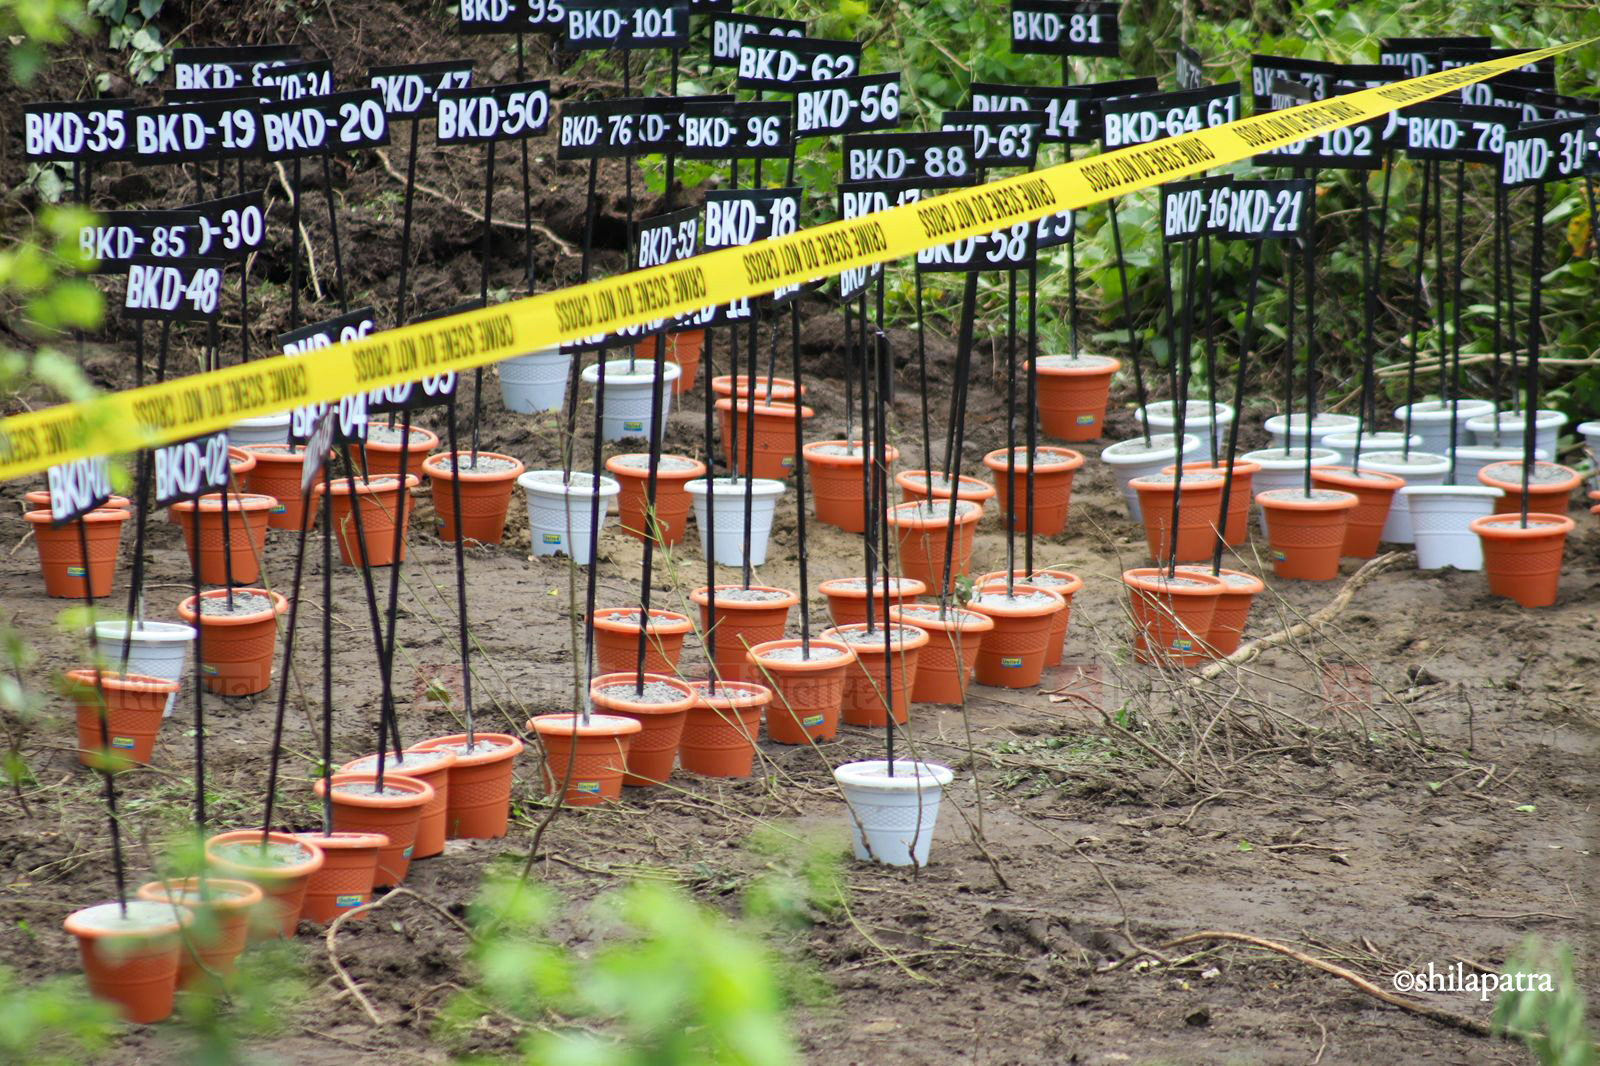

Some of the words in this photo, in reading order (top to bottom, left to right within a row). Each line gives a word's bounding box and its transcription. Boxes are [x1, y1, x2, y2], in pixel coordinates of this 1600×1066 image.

[175, 61, 286, 89] BKD-
[438, 90, 548, 140] BKD-50
[797, 82, 899, 131] BKD-56
[25, 109, 125, 154] BKD-35
[136, 109, 256, 154] BKD-19
[263, 100, 385, 152] BKD-20
[1105, 106, 1201, 146] BKD-64
[1144, 144, 1186, 174] SCENE
[1178, 138, 1216, 166] CRIME
[1018, 178, 1056, 210] CRIME
[1080, 162, 1121, 193] CROSS
[705, 196, 797, 246] BKD-18
[952, 197, 976, 229] NOT
[971, 194, 993, 224] DO
[986, 186, 1024, 219] SCENE
[1166, 187, 1231, 236] BKD-16
[850, 220, 887, 257] CRIME
[917, 204, 956, 239] CROSS
[638, 218, 697, 268] BKD-59
[779, 243, 803, 275] NOT
[801, 239, 820, 268] DO
[817, 230, 853, 266] SCENE
[671, 266, 707, 304] CRIME
[743, 248, 780, 286] CROSS
[125, 264, 221, 314] BKD-48
[593, 289, 617, 322] NOT
[617, 285, 635, 317] DO
[634, 275, 671, 313] SCENE
[555, 295, 593, 333] CROSS
[155, 434, 229, 501] BKD-02
